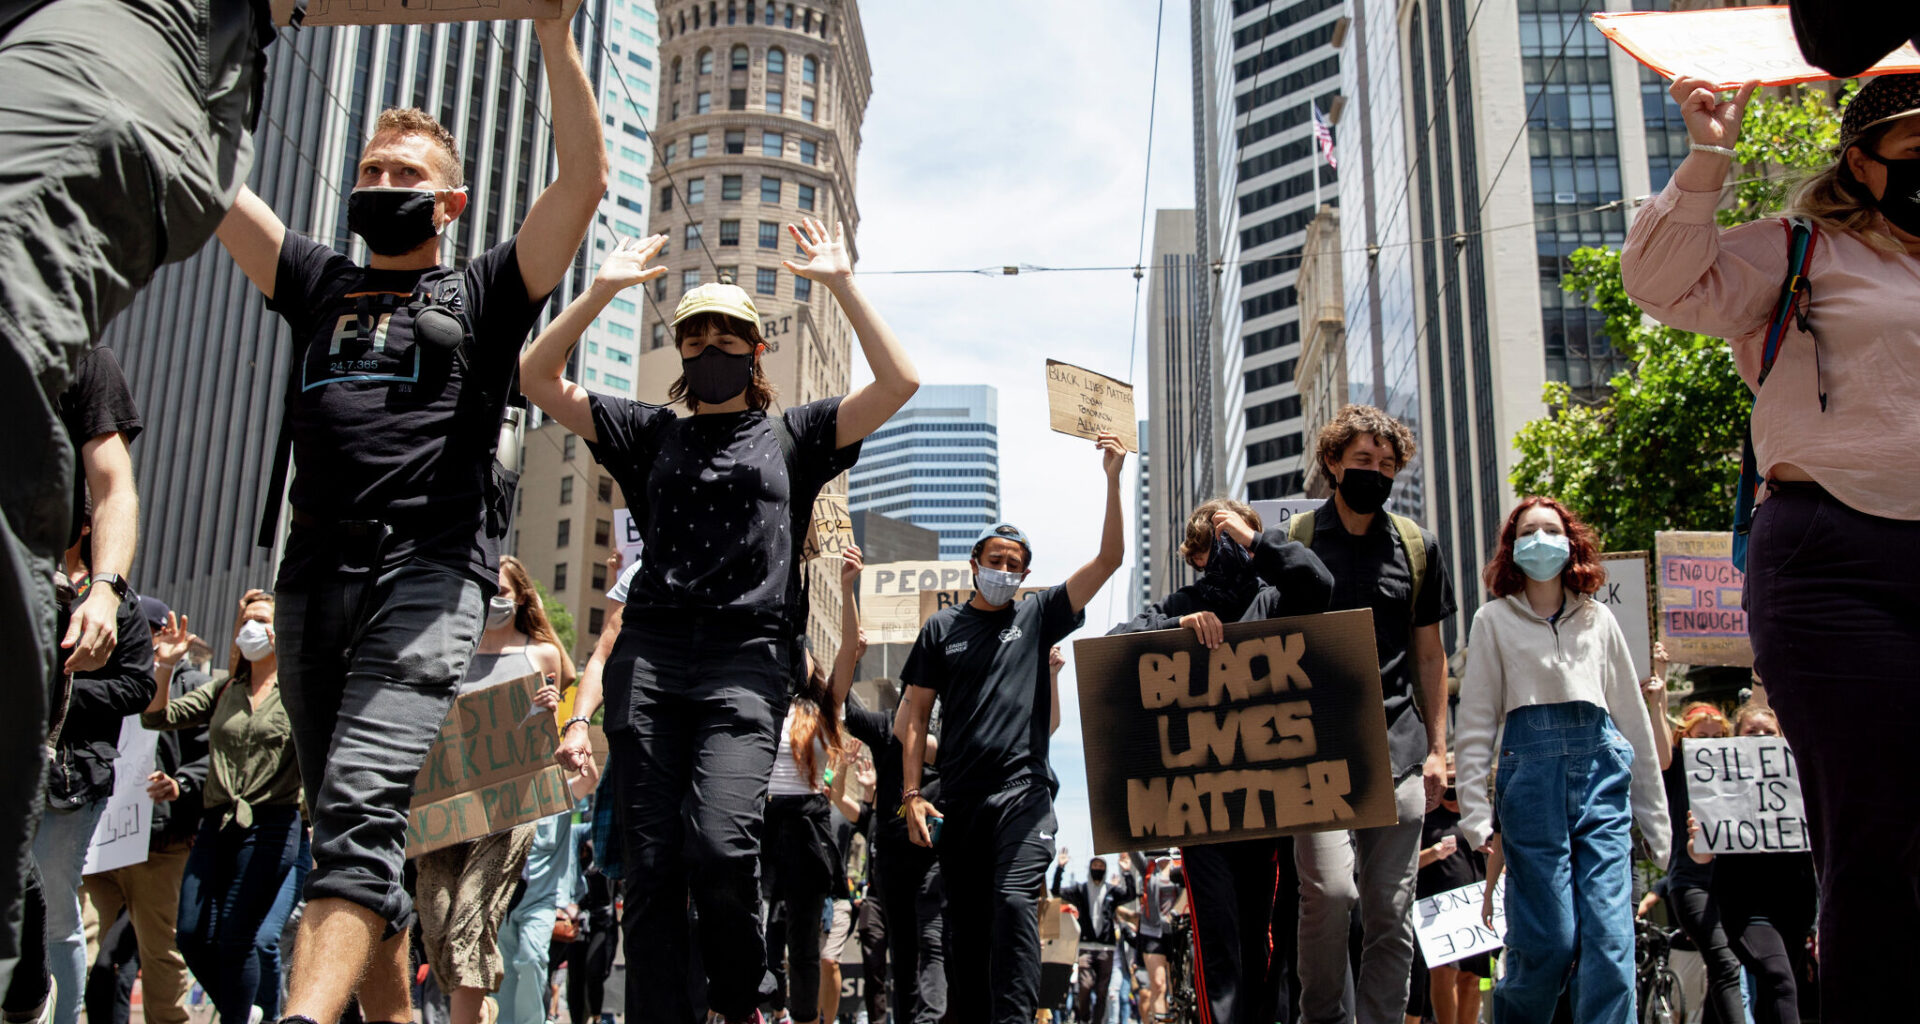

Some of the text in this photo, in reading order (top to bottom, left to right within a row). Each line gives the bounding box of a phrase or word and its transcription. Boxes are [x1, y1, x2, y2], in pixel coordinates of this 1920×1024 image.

[1048, 365, 1080, 387] BLACK
[1084, 377, 1105, 395] LIVES
[1080, 393, 1103, 409] TODAY
[815, 519, 852, 533] FOR
[875, 569, 973, 594] PEOPL
[1668, 561, 1744, 584] ENOUGH
[1697, 590, 1714, 608] IS
[1671, 611, 1744, 631] ENOUGH
[1138, 632, 1313, 710] BLACK
[485, 718, 555, 771] LIVES
[1156, 700, 1318, 769] LIVES
[1126, 758, 1356, 837] MATTER
[1755, 781, 1789, 812] IS
[1431, 925, 1499, 958] NCE
